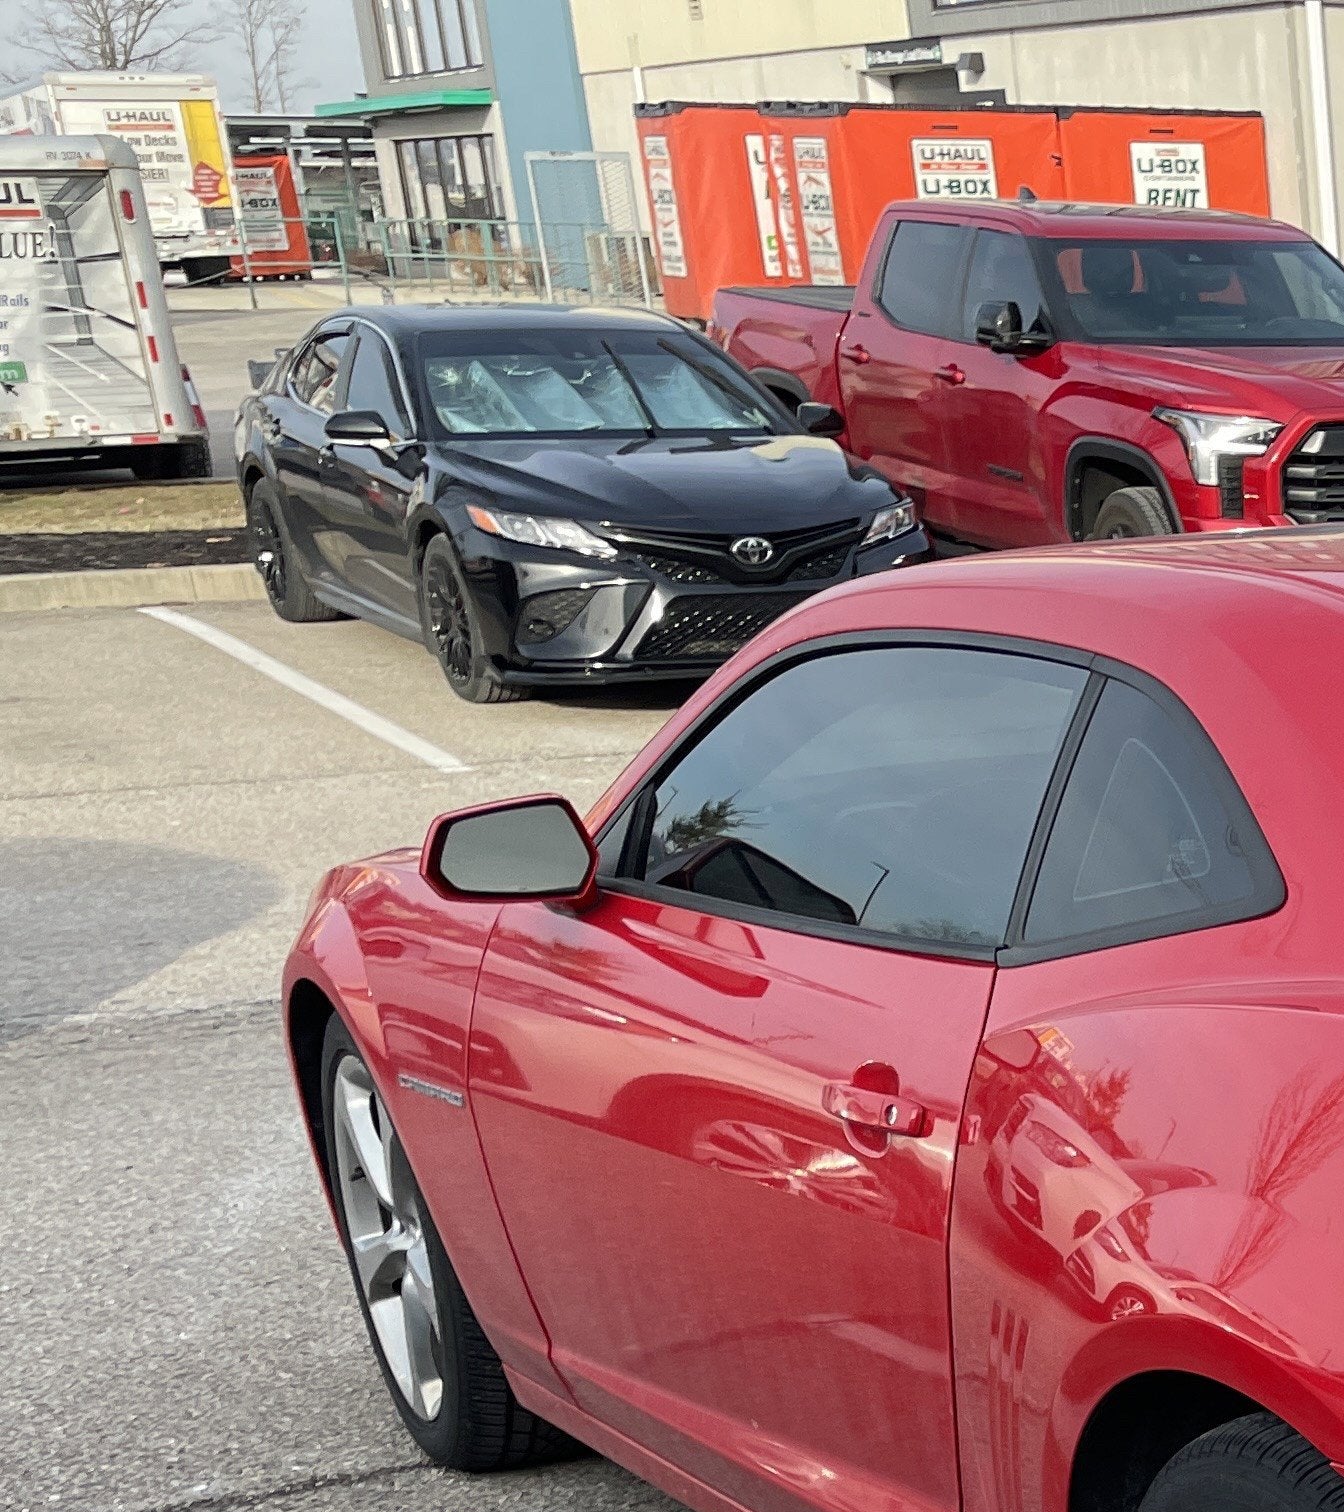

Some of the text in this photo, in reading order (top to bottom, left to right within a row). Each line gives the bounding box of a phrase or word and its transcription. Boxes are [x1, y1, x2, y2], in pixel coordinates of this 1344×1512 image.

[106, 111, 172, 122] U-HAUL
[921, 148, 986, 161] U-HAUL
[1137, 158, 1200, 174] U-BOX
[922, 179, 992, 195] U-BOX
[1147, 188, 1200, 208] RENT
